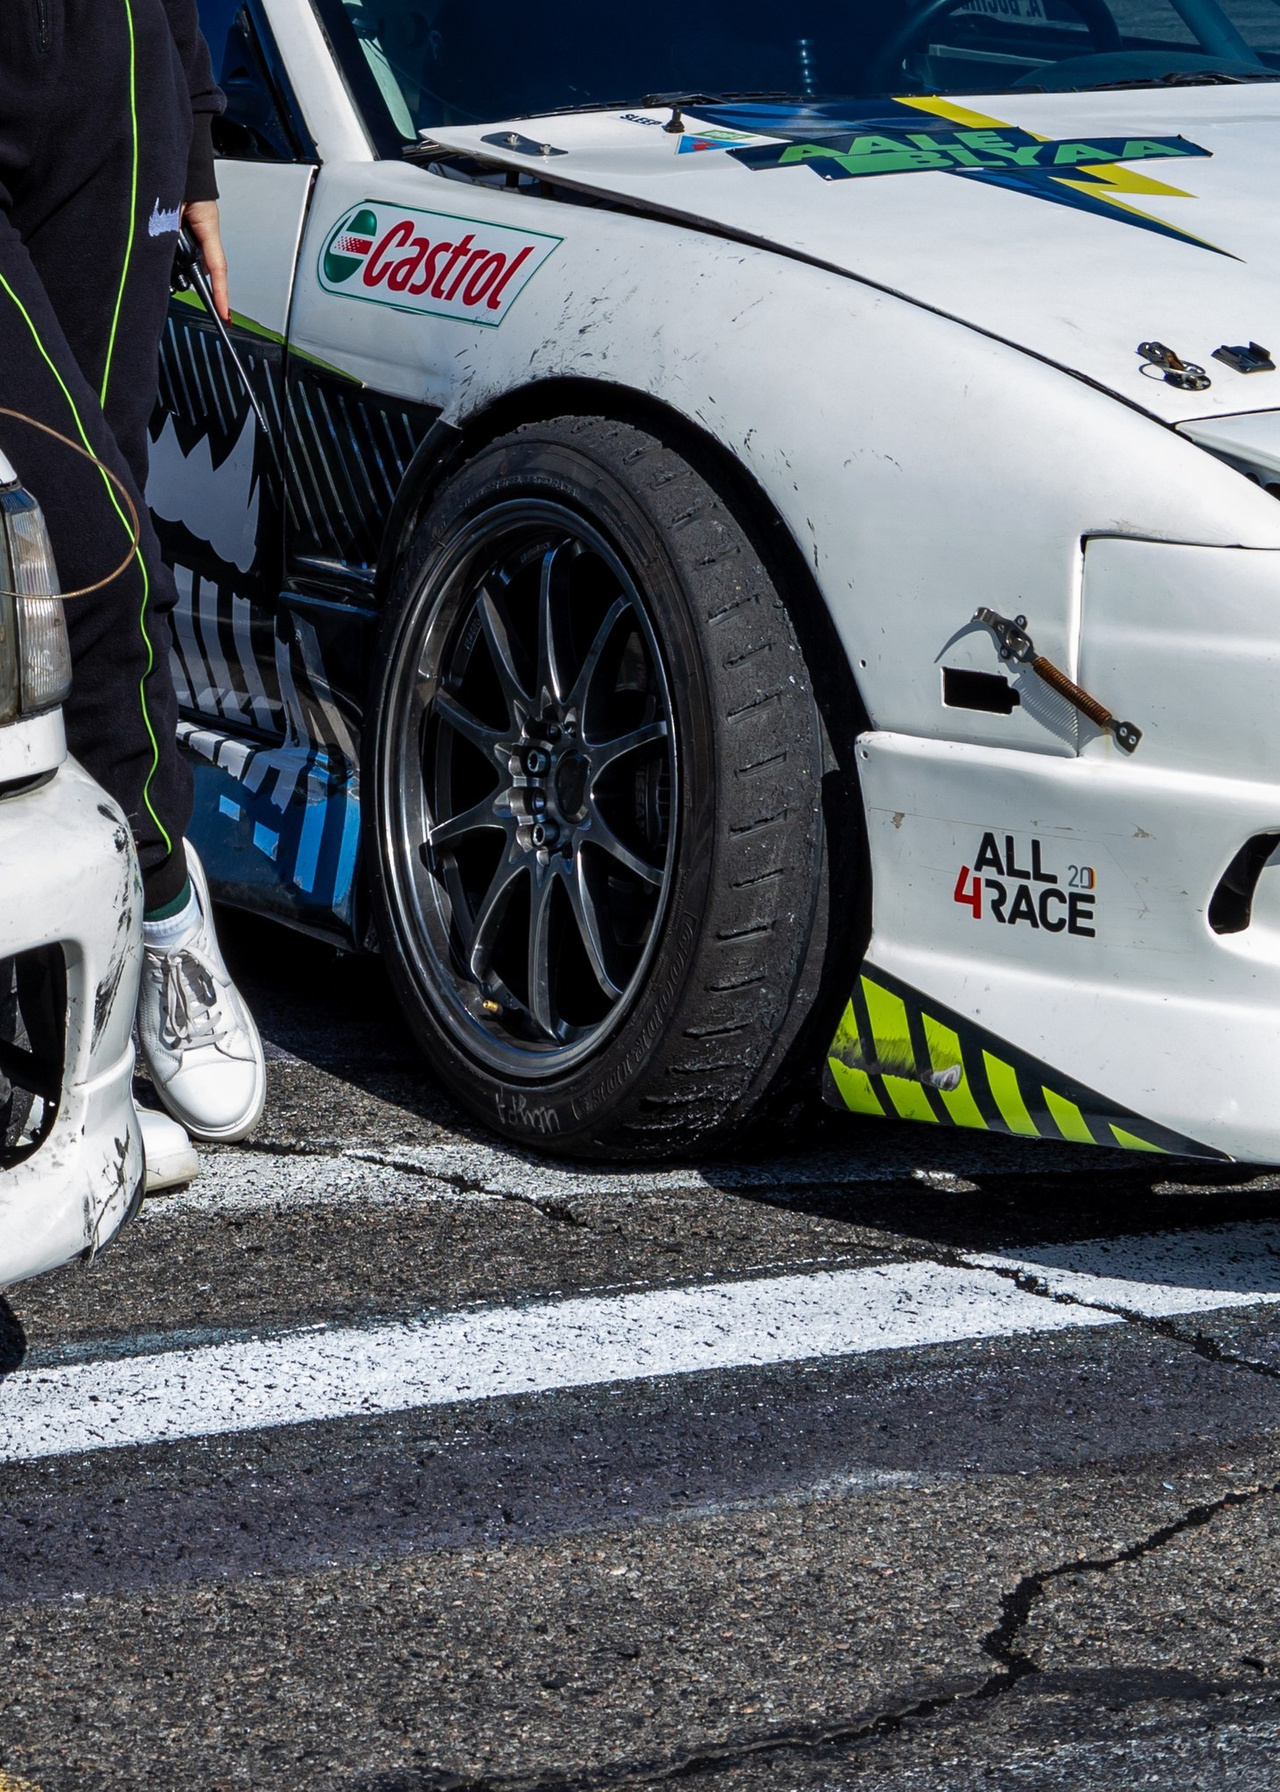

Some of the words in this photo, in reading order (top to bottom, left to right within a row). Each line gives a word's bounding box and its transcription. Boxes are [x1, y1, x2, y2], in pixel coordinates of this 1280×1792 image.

[620, 113, 662, 126] SLEEP
[778, 130, 1016, 164] AALE
[833, 140, 1190, 175] BLYAA
[362, 220, 535, 310] Castrol
[974, 832, 1058, 884] ALL
